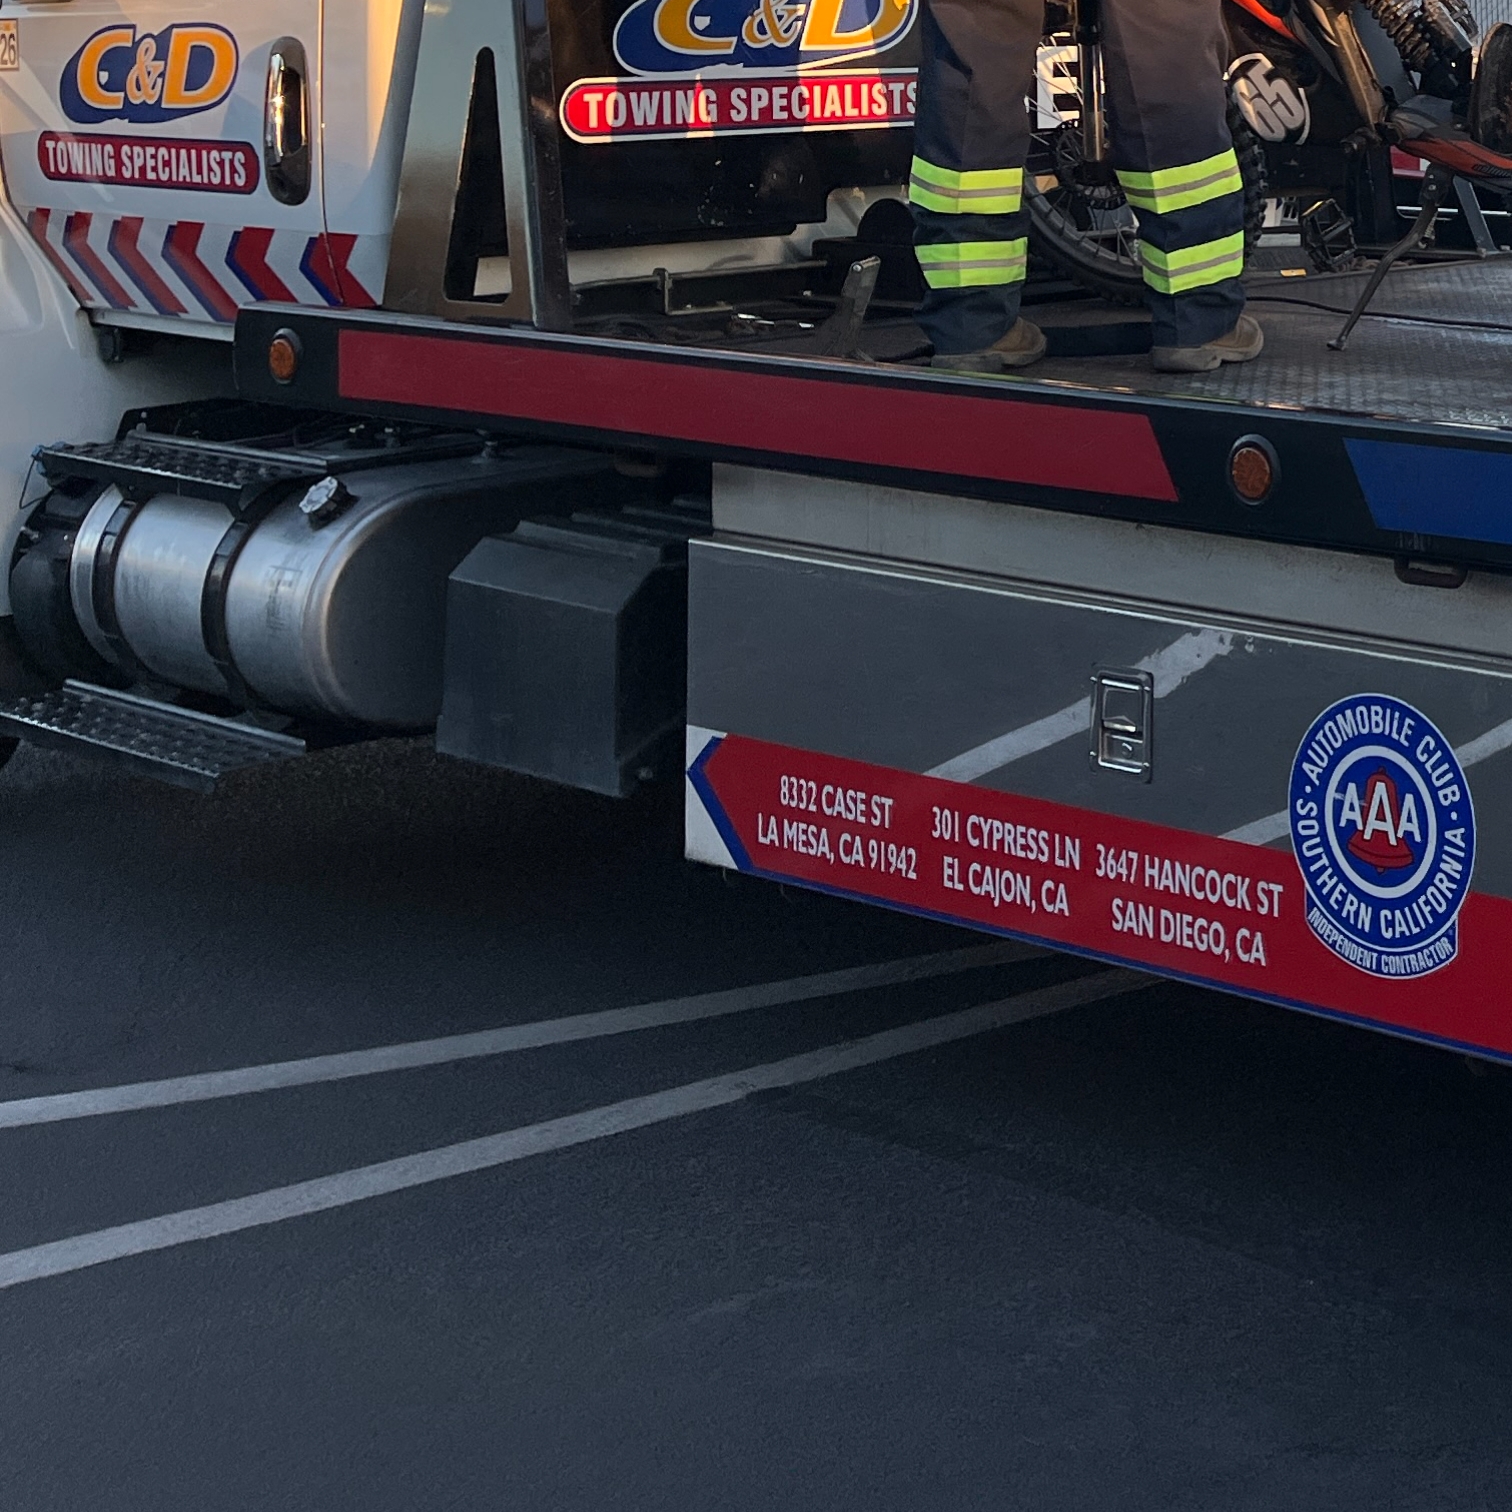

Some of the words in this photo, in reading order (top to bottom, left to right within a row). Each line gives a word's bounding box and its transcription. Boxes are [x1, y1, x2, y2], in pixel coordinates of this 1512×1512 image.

[76, 26, 238, 110] C&D
[1232, 59, 1306, 143] 65
[583, 88, 718, 129] TOWING
[45, 139, 117, 177] TOWING
[120, 144, 247, 187] SPECIALISTS
[1302, 705, 1416, 786] AUTOMOBILE
[1415, 734, 1461, 807] CLUB
[779, 774, 817, 813] 8332
[821, 784, 866, 824] CASE
[870, 794, 893, 829] ST
[1338, 781, 1422, 847] AAA
[757, 812, 779, 847] LA
[783, 818, 835, 866] MESA,
[839, 832, 865, 868] CA
[869, 839, 918, 880] 91942
[931, 805, 960, 843] 301
[966, 814, 1050, 864] CYPRESS
[1054, 833, 1081, 871] LN
[1296, 798, 1373, 934] SOUTHERN
[1380, 826, 1466, 940] CALIFORNIA
[942, 855, 964, 891] EL
[968, 862, 1037, 914] CAJON,
[1040, 880, 1070, 916] CA
[1095, 843, 1139, 884] 3647
[1144, 854, 1252, 912] HANCOCK
[1257, 880, 1284, 918] ST
[1111, 897, 1154, 939] SAN
[1159, 908, 1231, 964] DIEGO,
[1235, 927, 1267, 967] CA
[1308, 906, 1379, 970] INDEPENDENT
[1380, 936, 1454, 975] CONTRACTOR
